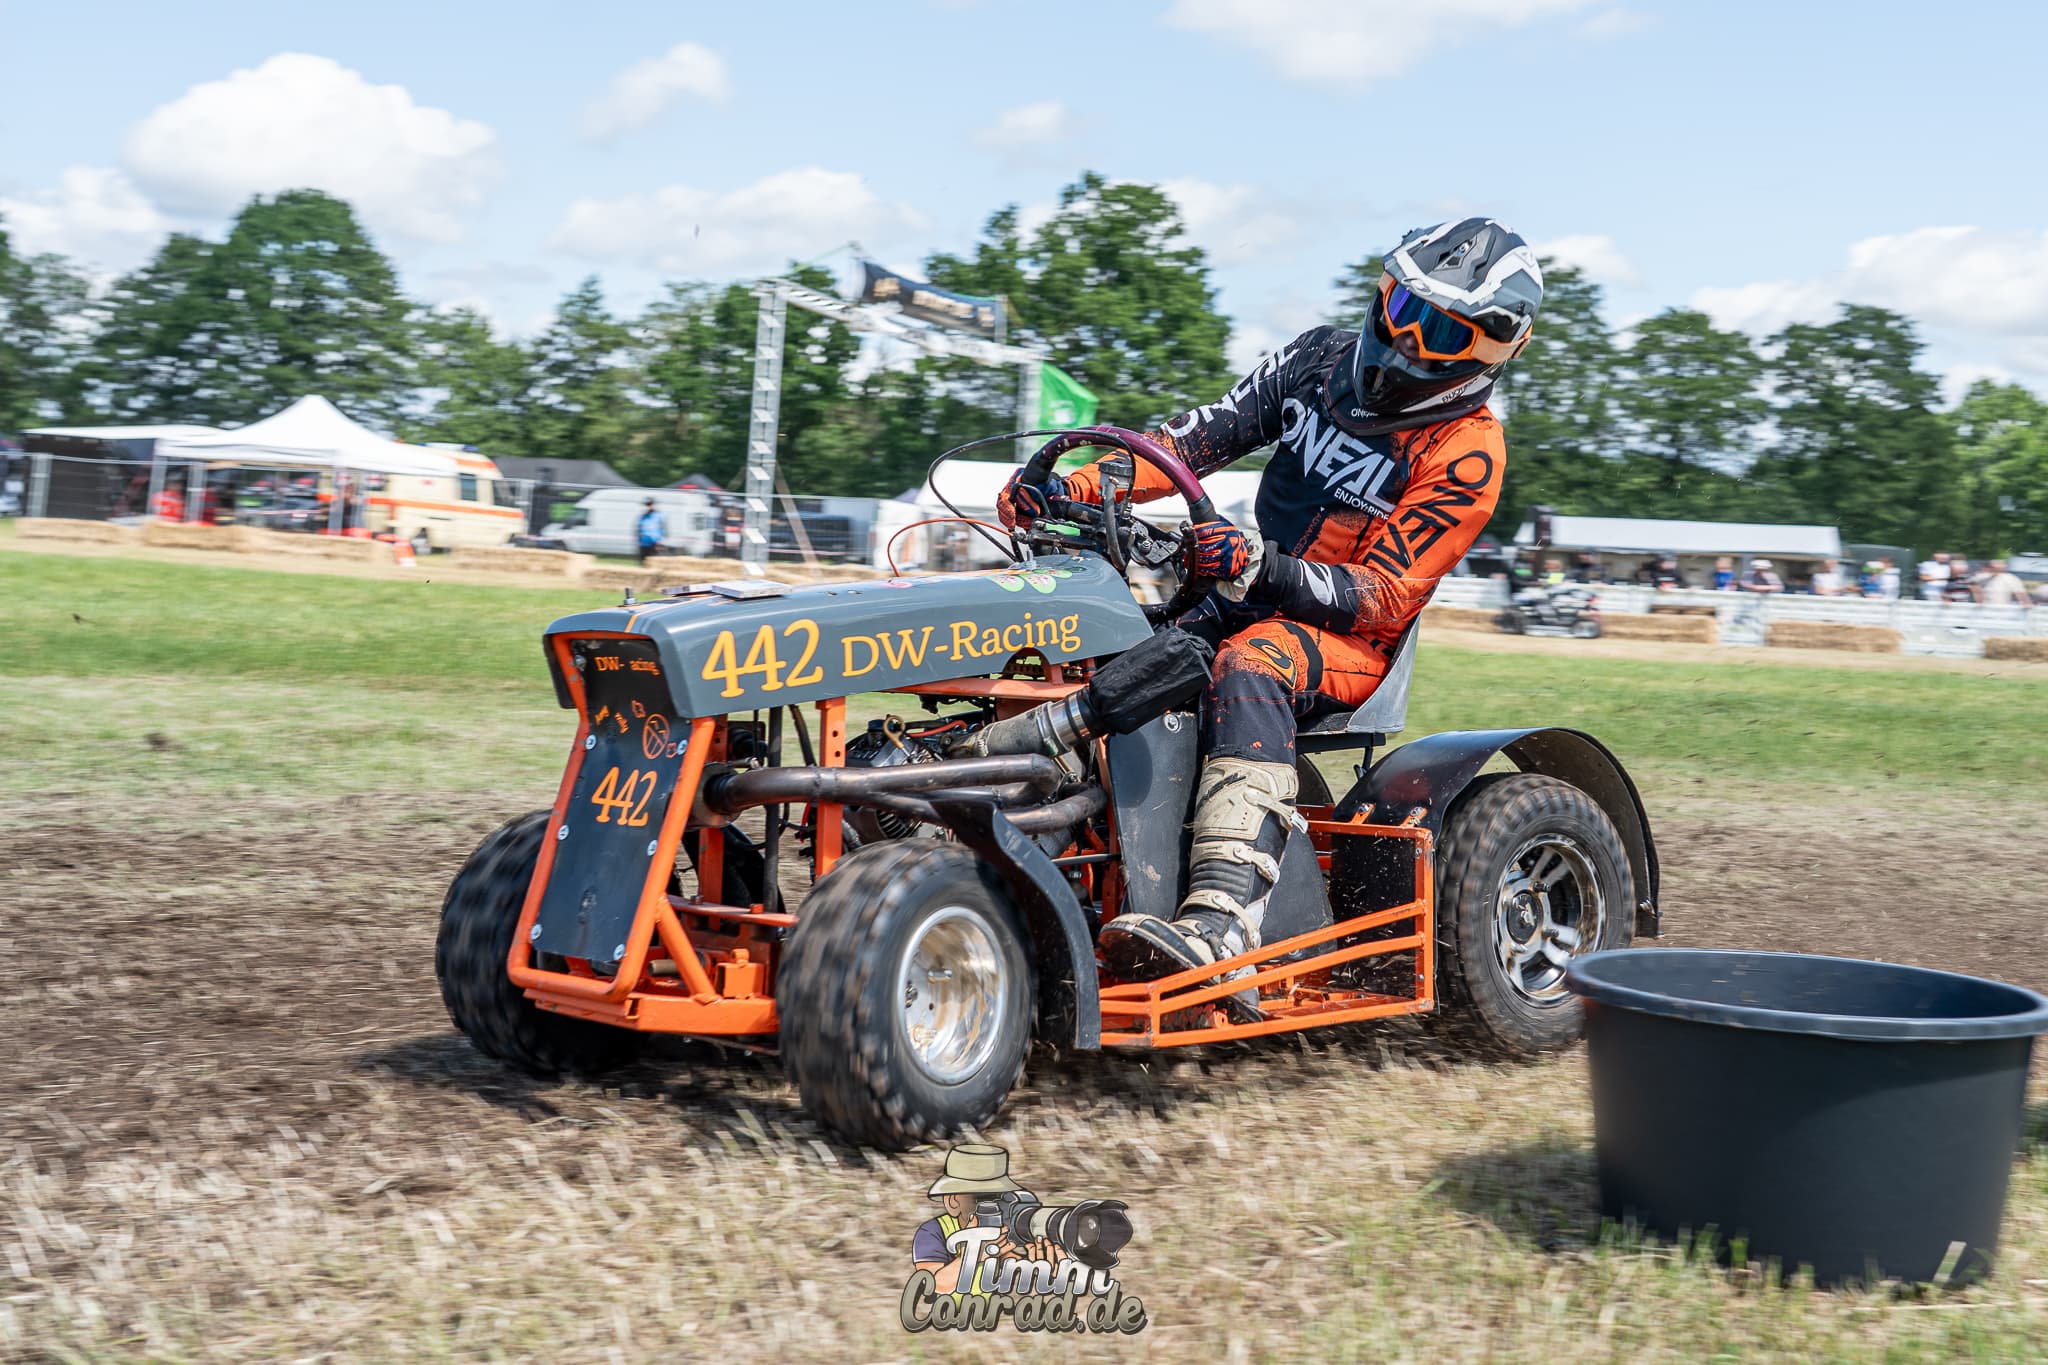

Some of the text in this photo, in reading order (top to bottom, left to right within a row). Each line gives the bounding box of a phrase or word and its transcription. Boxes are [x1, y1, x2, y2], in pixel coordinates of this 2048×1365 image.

[1334, 488, 1367, 511] ENJOY
[702, 612, 1082, 698] 442 DW-Racing
[592, 766, 658, 826] 442
